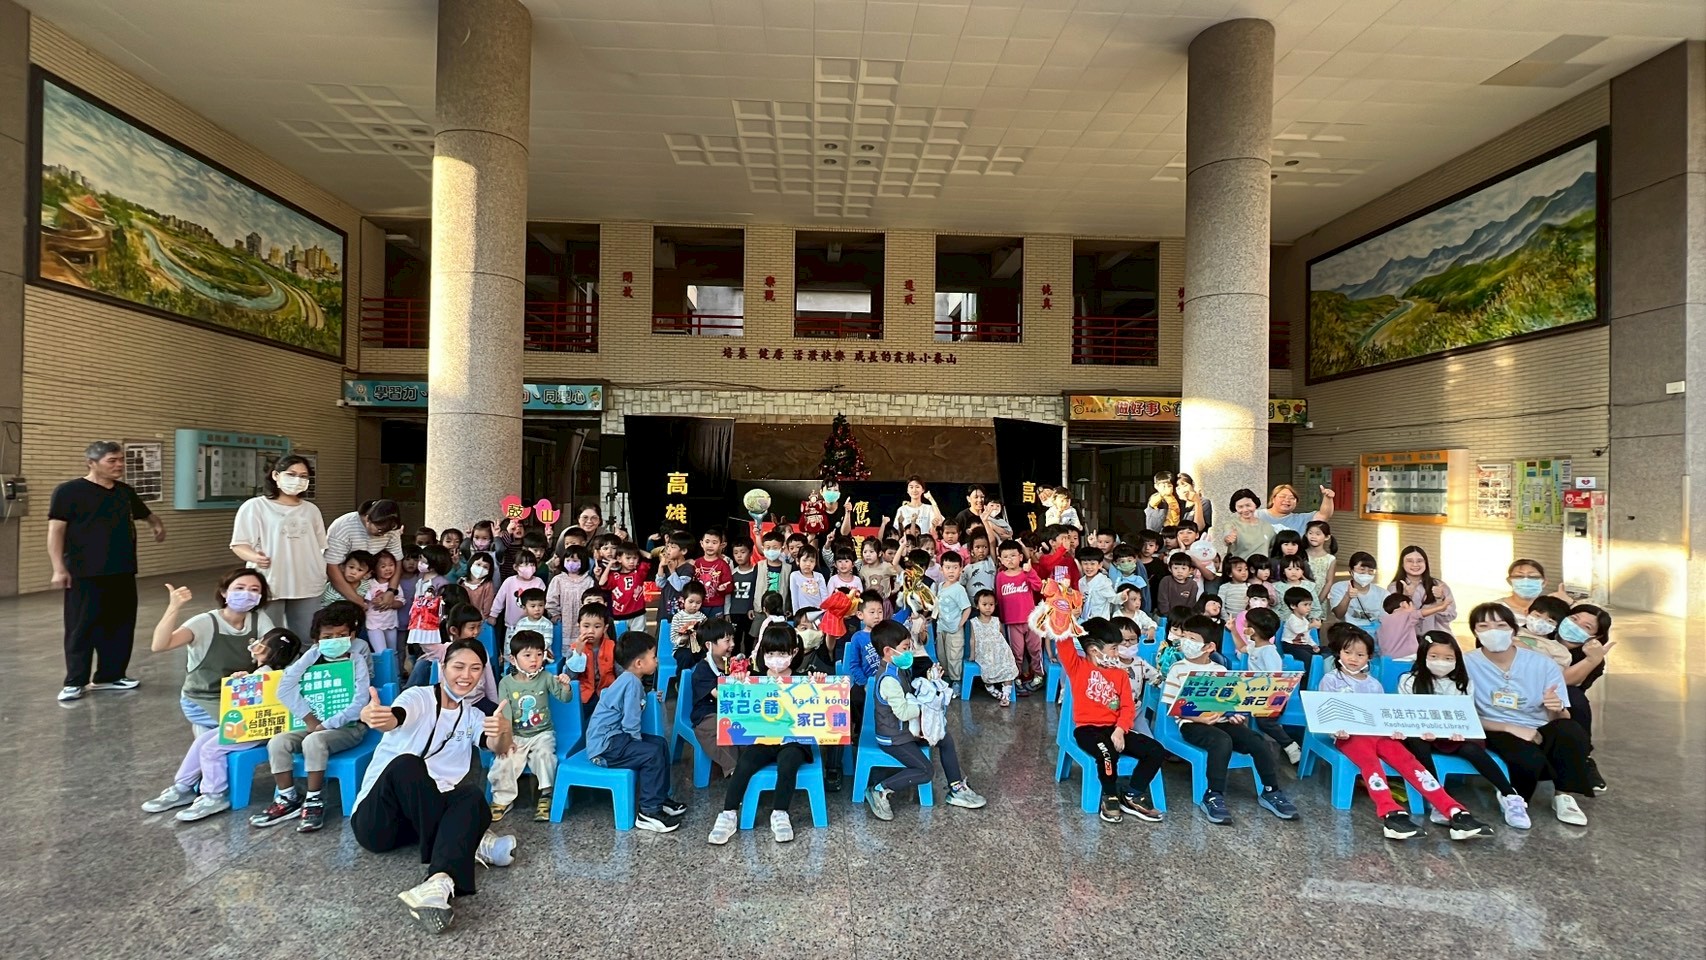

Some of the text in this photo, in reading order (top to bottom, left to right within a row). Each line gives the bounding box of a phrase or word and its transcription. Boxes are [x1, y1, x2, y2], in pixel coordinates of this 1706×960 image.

[665, 471, 689, 524] 高雄
[508, 504, 523, 519] 鼓
[541, 509, 554, 522] 山
[734, 581, 751, 599] 17
[303, 678, 342, 692] 台語家庭
[1380, 708, 1467, 721] 高雄市立圖書館
[1383, 721, 1470, 731] Kaohsiung Public Library
